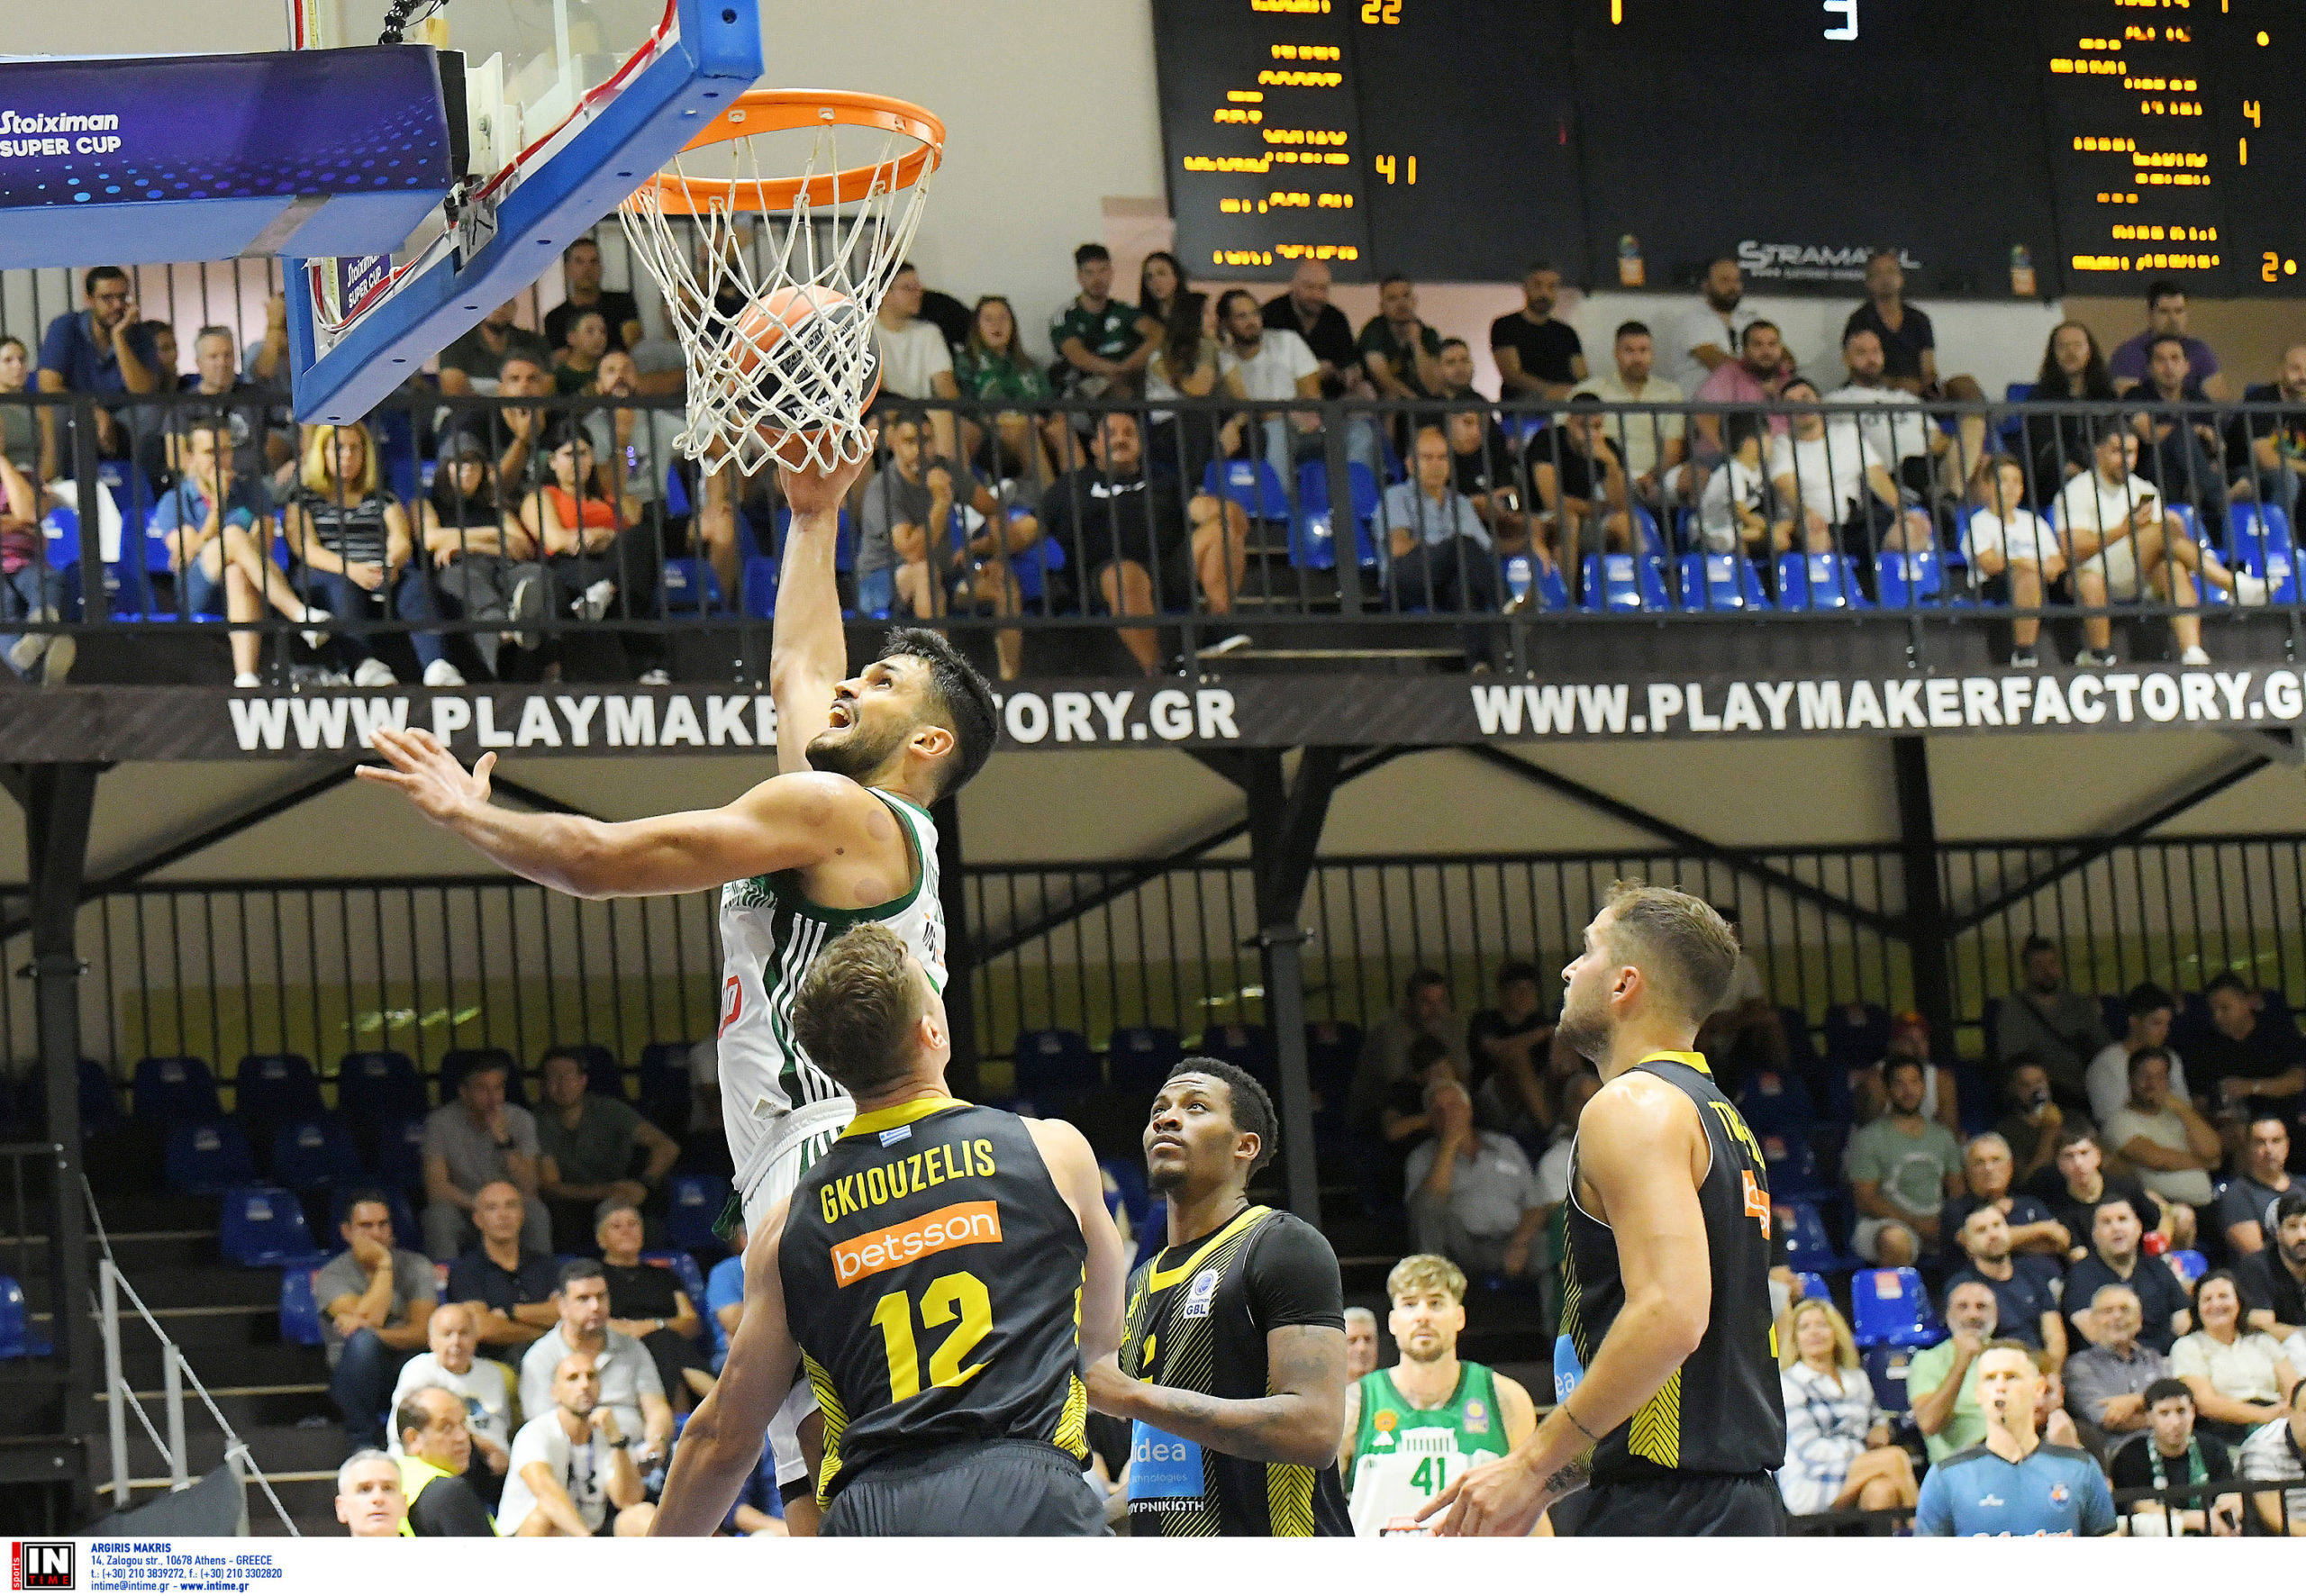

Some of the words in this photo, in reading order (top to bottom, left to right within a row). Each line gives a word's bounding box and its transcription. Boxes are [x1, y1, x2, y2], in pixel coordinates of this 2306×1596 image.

[0, 110, 119, 134] Stoiximan
[0, 138, 70, 158] SUPER
[76, 136, 122, 154] CUP
[1738, 240, 1921, 269] STRAMAL
[1470, 670, 2306, 735] WWW.PLAYMAKERFACTORY.G
[821, 1138, 997, 1225] GKIOUZELIS
[835, 1211, 996, 1281] betsson
[1185, 1303, 1206, 1316] GBL
[870, 1270, 994, 1405] 12
[1410, 1456, 1447, 1496] 41
